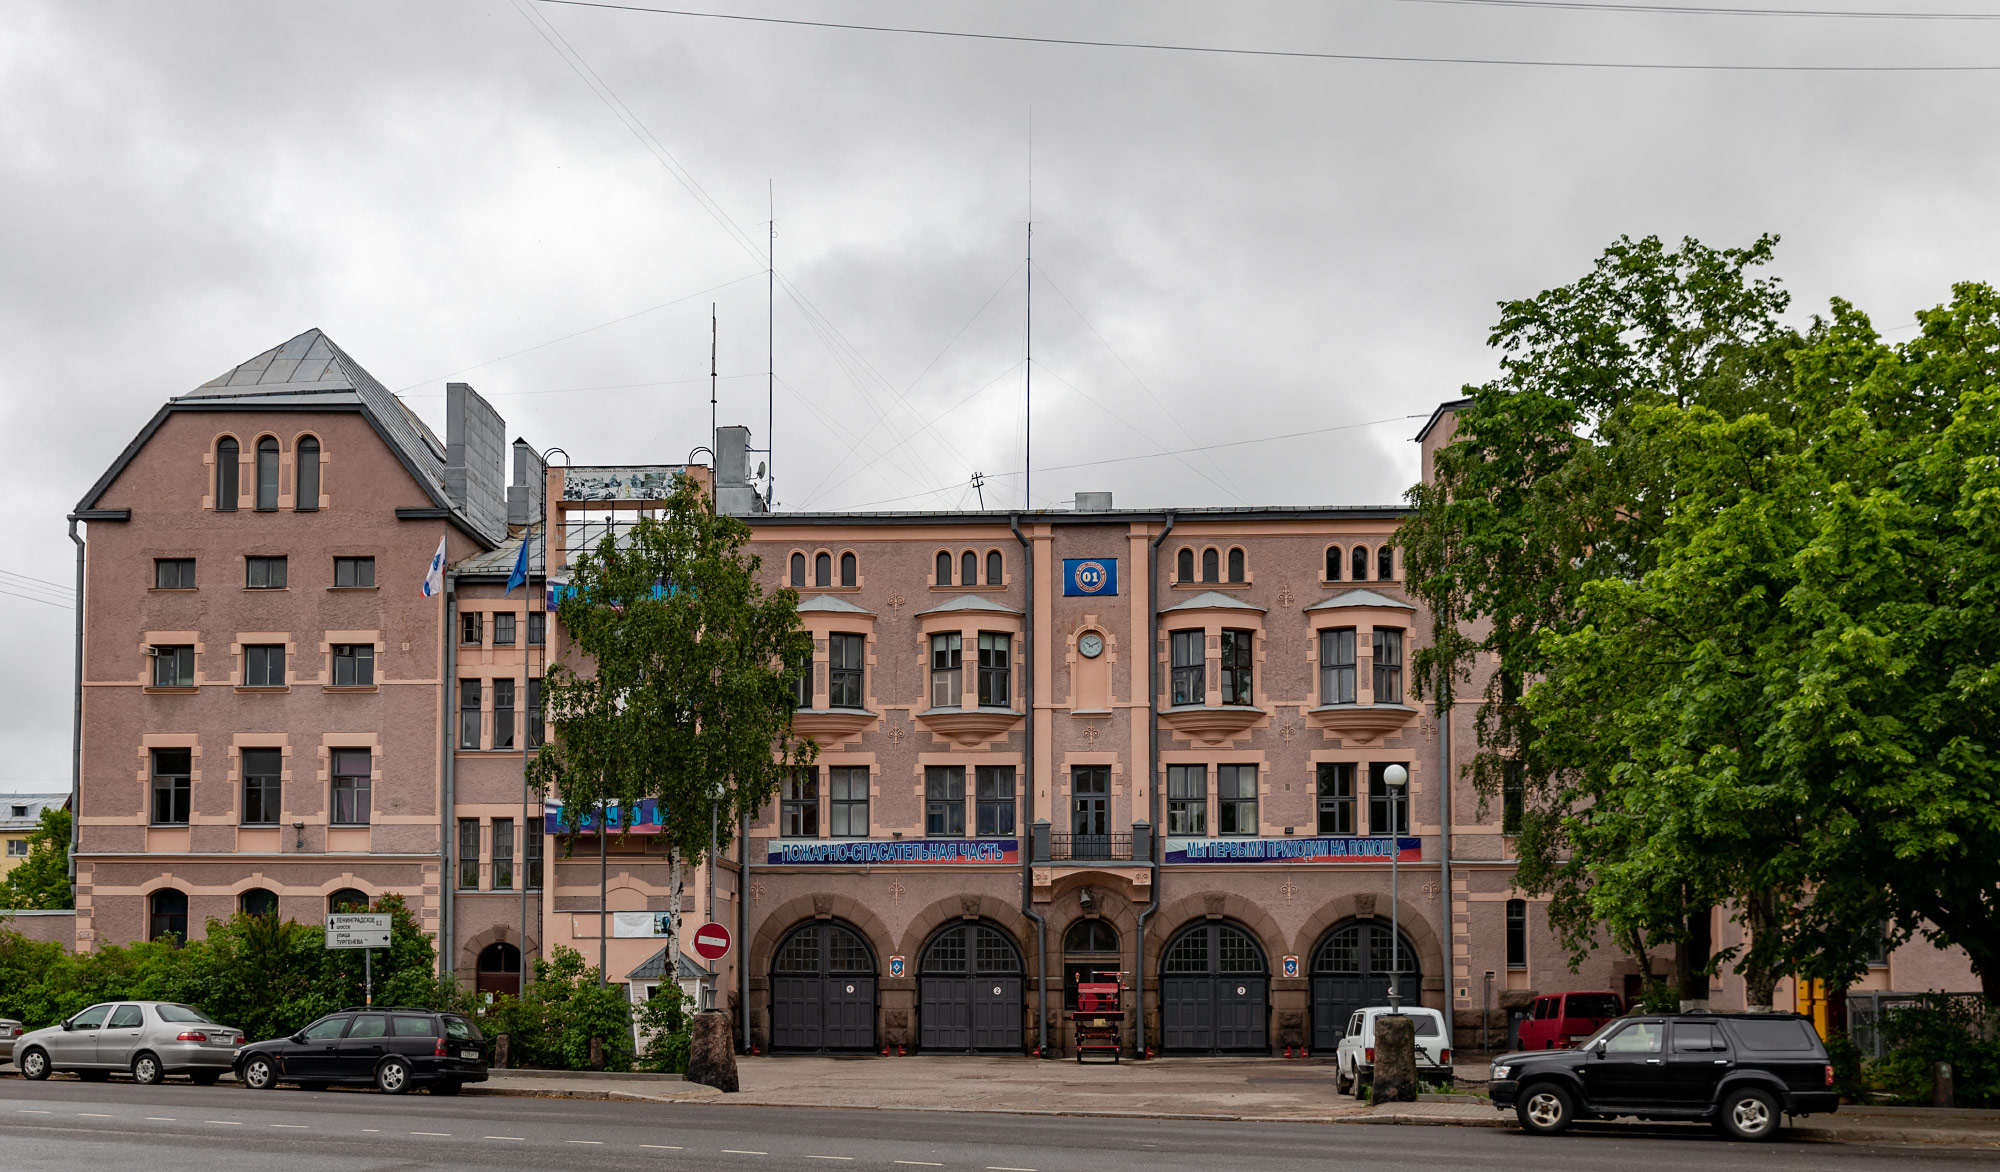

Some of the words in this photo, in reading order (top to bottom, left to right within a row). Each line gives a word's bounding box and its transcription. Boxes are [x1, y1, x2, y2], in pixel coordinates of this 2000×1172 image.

[1082, 571, 1098, 583] 01
[782, 843, 957, 861] ПОЖАРНО-СПАСАТЕЛЬНАЯ
[959, 842, 1004, 861] ЧАСТЬ
[1186, 841, 1207, 858] МЫ
[1208, 840, 1265, 858] ПЕРВЫМИ
[1267, 840, 1328, 860] ПРИХОДИМ
[1330, 840, 1347, 857] НА
